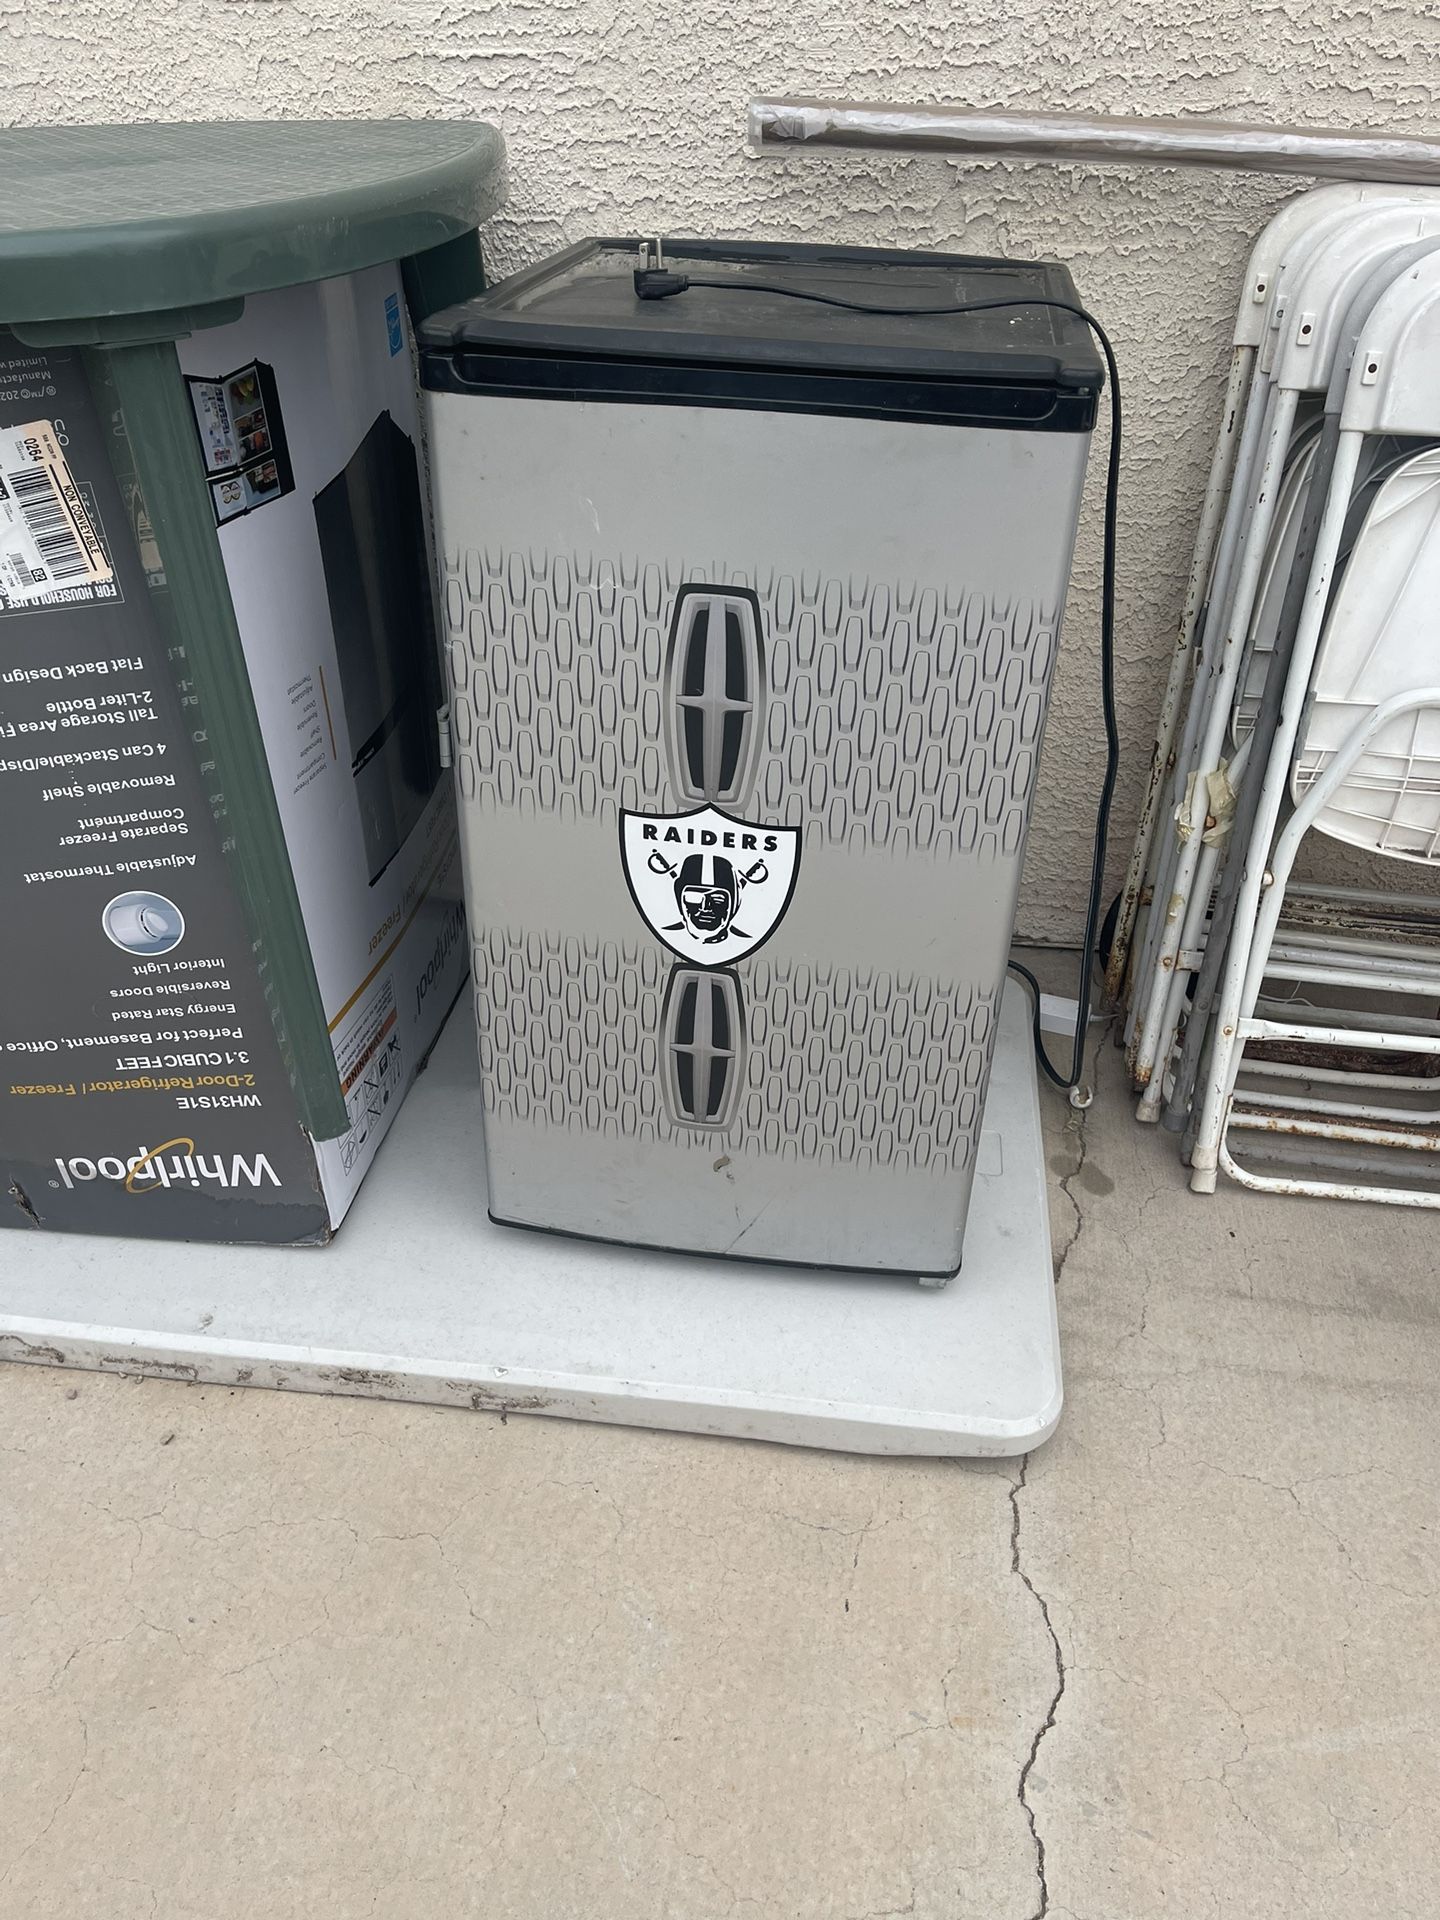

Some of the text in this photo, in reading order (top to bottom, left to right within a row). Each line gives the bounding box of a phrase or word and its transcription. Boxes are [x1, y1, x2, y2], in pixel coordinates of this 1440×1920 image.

[9, 356, 48, 370] Limited
[24, 437, 44, 462] 0264
[63, 484, 77, 502] NON
[71, 503, 100, 554] CONVEYABLE
[33, 568, 46, 581] 82
[95, 583, 118, 598] FOR
[2, 656, 144, 683] Flat Back Design
[46, 690, 153, 714] 2-Liter Bottle
[61, 711, 126, 728] Storage
[129, 707, 158, 722] Tall
[18, 719, 57, 732] Area
[122, 744, 153, 756] Can
[156, 742, 167, 755] 4
[42, 774, 176, 802] Removable Shelf
[78, 807, 185, 830] Compartment
[59, 822, 189, 846] Separate Freezer
[642, 823, 778, 852] RAIDERS
[24, 854, 197, 884] Adjustable Thermostat
[133, 958, 225, 976] Interior Light
[109, 979, 231, 998] Reversible Doors
[112, 1003, 236, 1021] Energy Star Rated
[61, 1033, 153, 1049] Basement,
[155, 1030, 180, 1043] for
[182, 1026, 244, 1041] Perfect
[6, 1040, 58, 1053] Office
[115, 1051, 250, 1072] 3.1 CUBIC FEET
[89, 1076, 195, 1093] Refrigerator
[197, 1073, 256, 1087] 2-Door
[10, 1083, 77, 1096] Freezer
[176, 1094, 262, 1110] WH31S1E
[54, 1145, 283, 1189] Whirlpool
